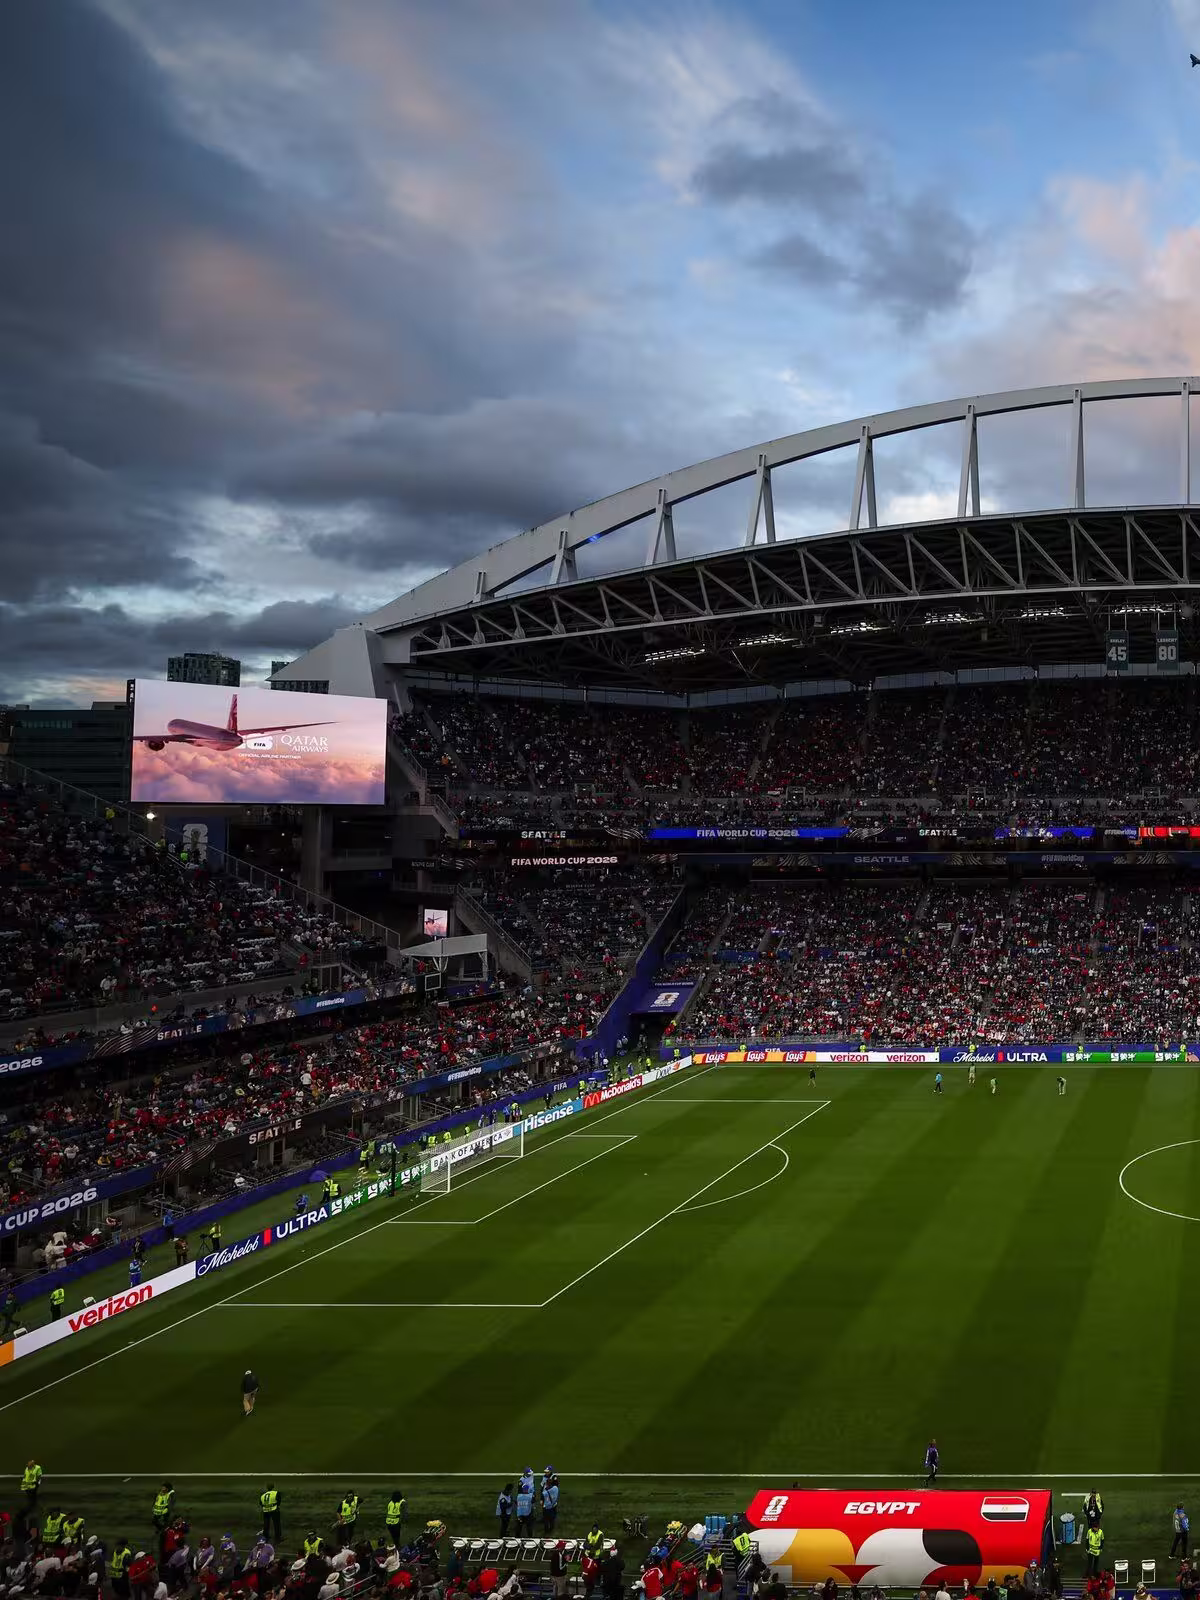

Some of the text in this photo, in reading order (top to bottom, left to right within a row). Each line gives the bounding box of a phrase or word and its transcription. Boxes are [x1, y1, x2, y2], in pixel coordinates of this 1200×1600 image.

[1108, 646, 1127, 661] 45
[1158, 646, 1176, 661] 80
[280, 734, 328, 746] QATAR
[521, 830, 567, 840] SEATTLE
[696, 829, 800, 838] FIFA WORLD CUP 2026
[919, 828, 958, 837] SEATTLE
[511, 858, 532, 866] FIFA
[532, 858, 566, 866] WORLD
[586, 856, 618, 864] 2026
[157, 1025, 202, 1041] SEATTLE
[706, 1052, 726, 1063] Lay's
[746, 1052, 765, 1062] Lay's
[786, 1052, 804, 1062] Lay's
[830, 1053, 869, 1062] verizon
[886, 1053, 926, 1062] verizon
[952, 1052, 1048, 1063] Michelob ULTRA
[0, 1056, 43, 1073] 2026
[448, 1066, 482, 1082] #FIFAWorldCup
[554, 1082, 568, 1092] FIFA
[600, 1077, 642, 1102] McDonald's
[524, 1104, 574, 1133] Hisense
[248, 1118, 302, 1146] SEATTLE
[458, 1148, 468, 1157] OF
[470, 1133, 503, 1152] AMERCA
[5, 1187, 98, 1230] CUP 2026
[197, 1206, 328, 1276] Michelob ULTRA
[68, 1284, 153, 1333] verizon
[843, 1502, 921, 1515] EGYPT
